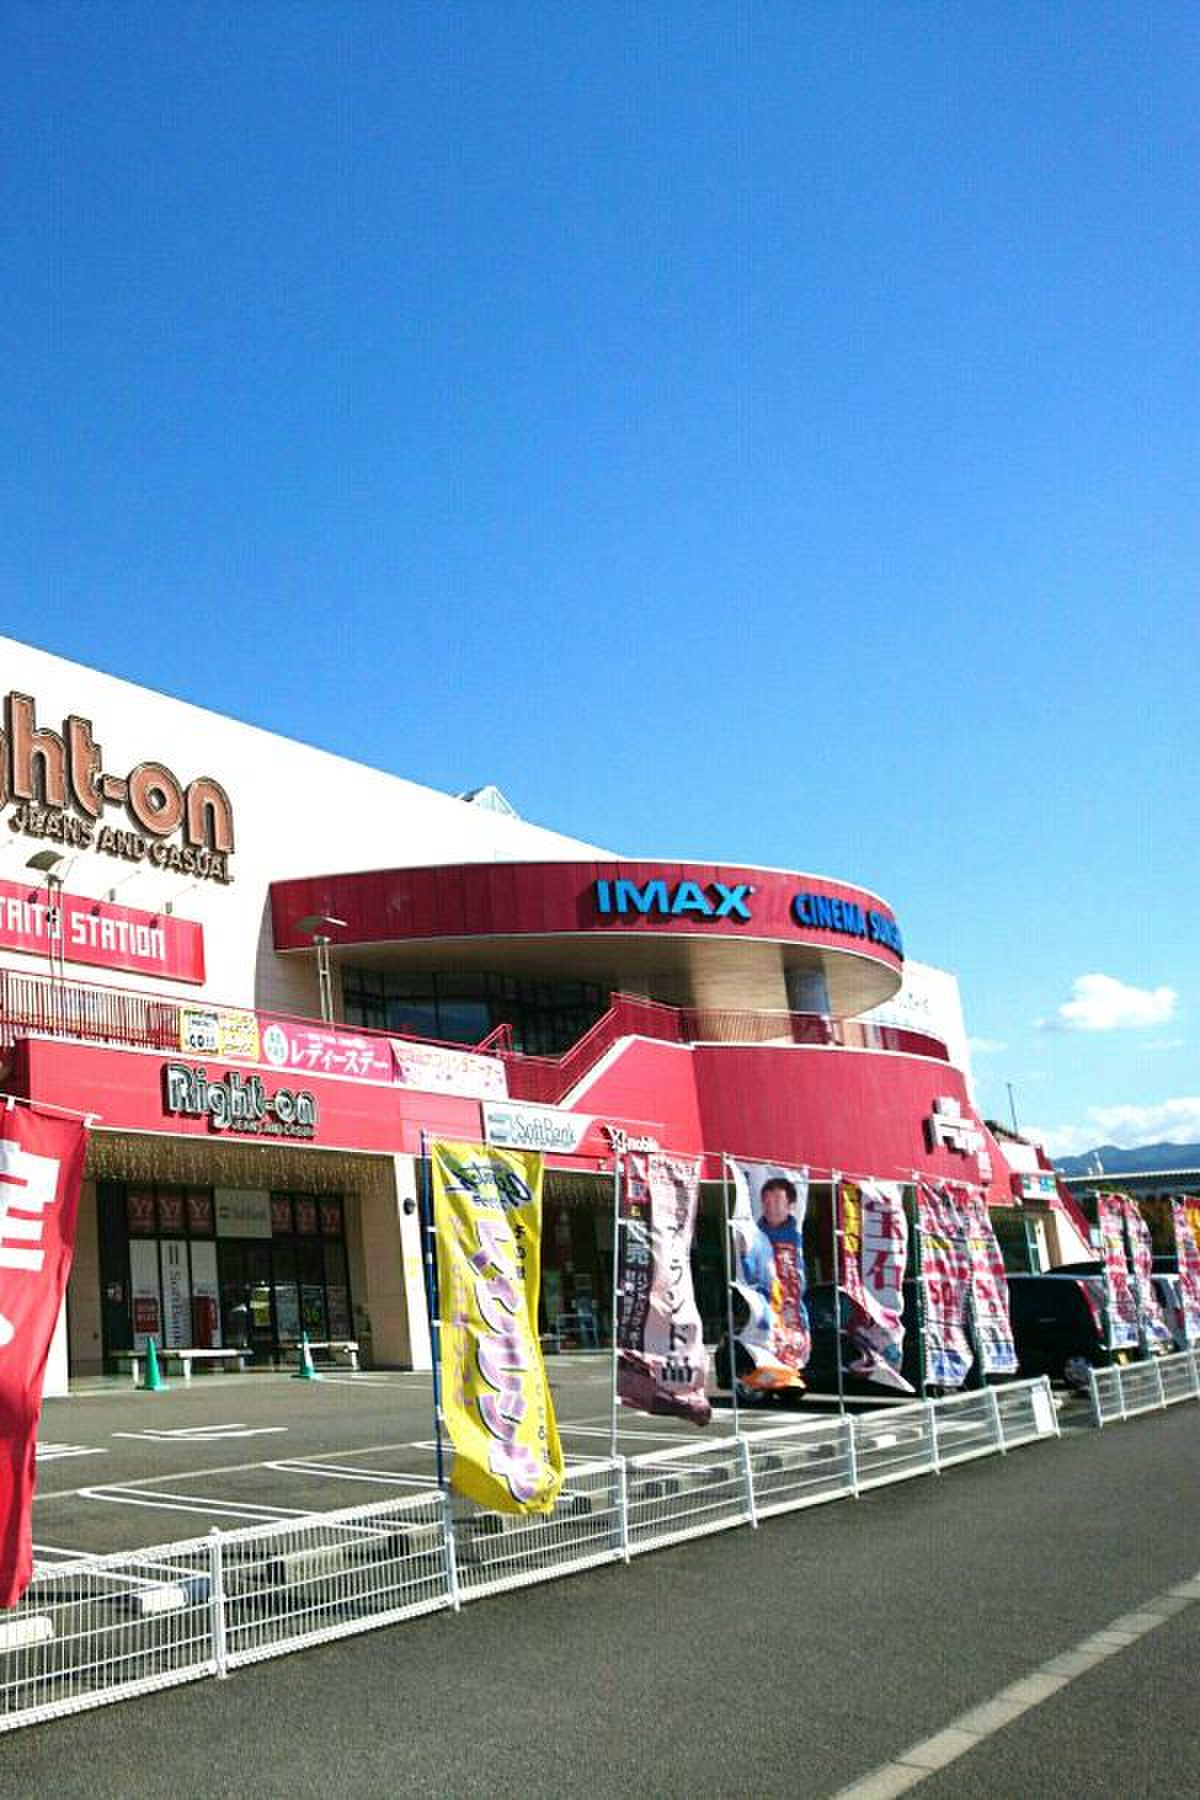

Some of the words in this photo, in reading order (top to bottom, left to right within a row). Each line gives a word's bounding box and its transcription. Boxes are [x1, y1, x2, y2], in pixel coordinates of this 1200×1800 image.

[11, 803, 95, 849] JEANS
[97, 824, 147, 862] AND
[150, 838, 234, 885] CASUAL
[596, 879, 751, 918] IMAX
[792, 893, 865, 935] CINEMA
[71, 911, 166, 961] STATION
[290, 1038, 389, 1073] レディースデー
[165, 1062, 317, 1128] Right-on
[512, 1114, 576, 1147] SoftBank
